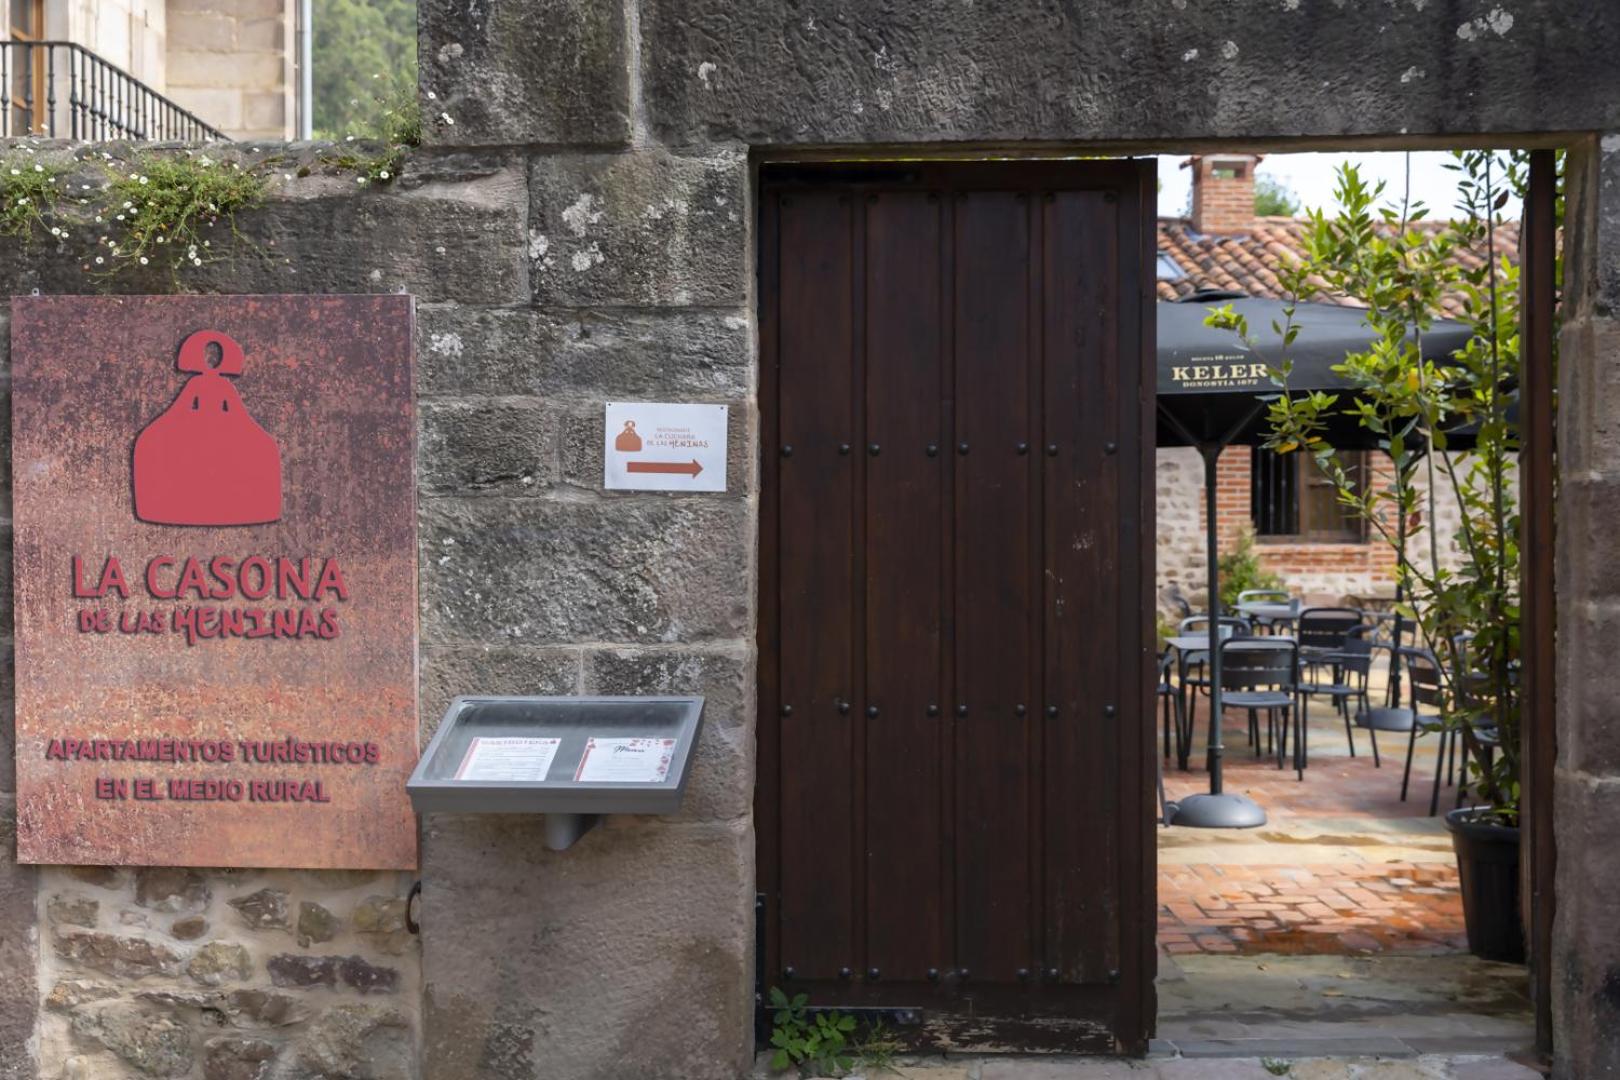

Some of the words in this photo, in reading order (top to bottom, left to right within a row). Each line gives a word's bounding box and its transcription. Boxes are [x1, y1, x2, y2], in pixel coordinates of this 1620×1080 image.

[1172, 364, 1268, 380] KELER
[1183, 380, 1235, 388] DONOSTIA
[668, 440, 709, 448] MENINAS
[72, 554, 129, 599] LA
[144, 553, 348, 601] CASONA
[78, 608, 112, 633] DE
[119, 609, 166, 634] LAS
[172, 606, 340, 646] MENINAS
[46, 739, 235, 763] APARTAMENTOS
[239, 736, 381, 764] TURÍSTICOS
[96, 777, 129, 800] EN
[134, 777, 165, 801] EL
[169, 779, 245, 802] MEDIO
[249, 779, 331, 803] RURAL
